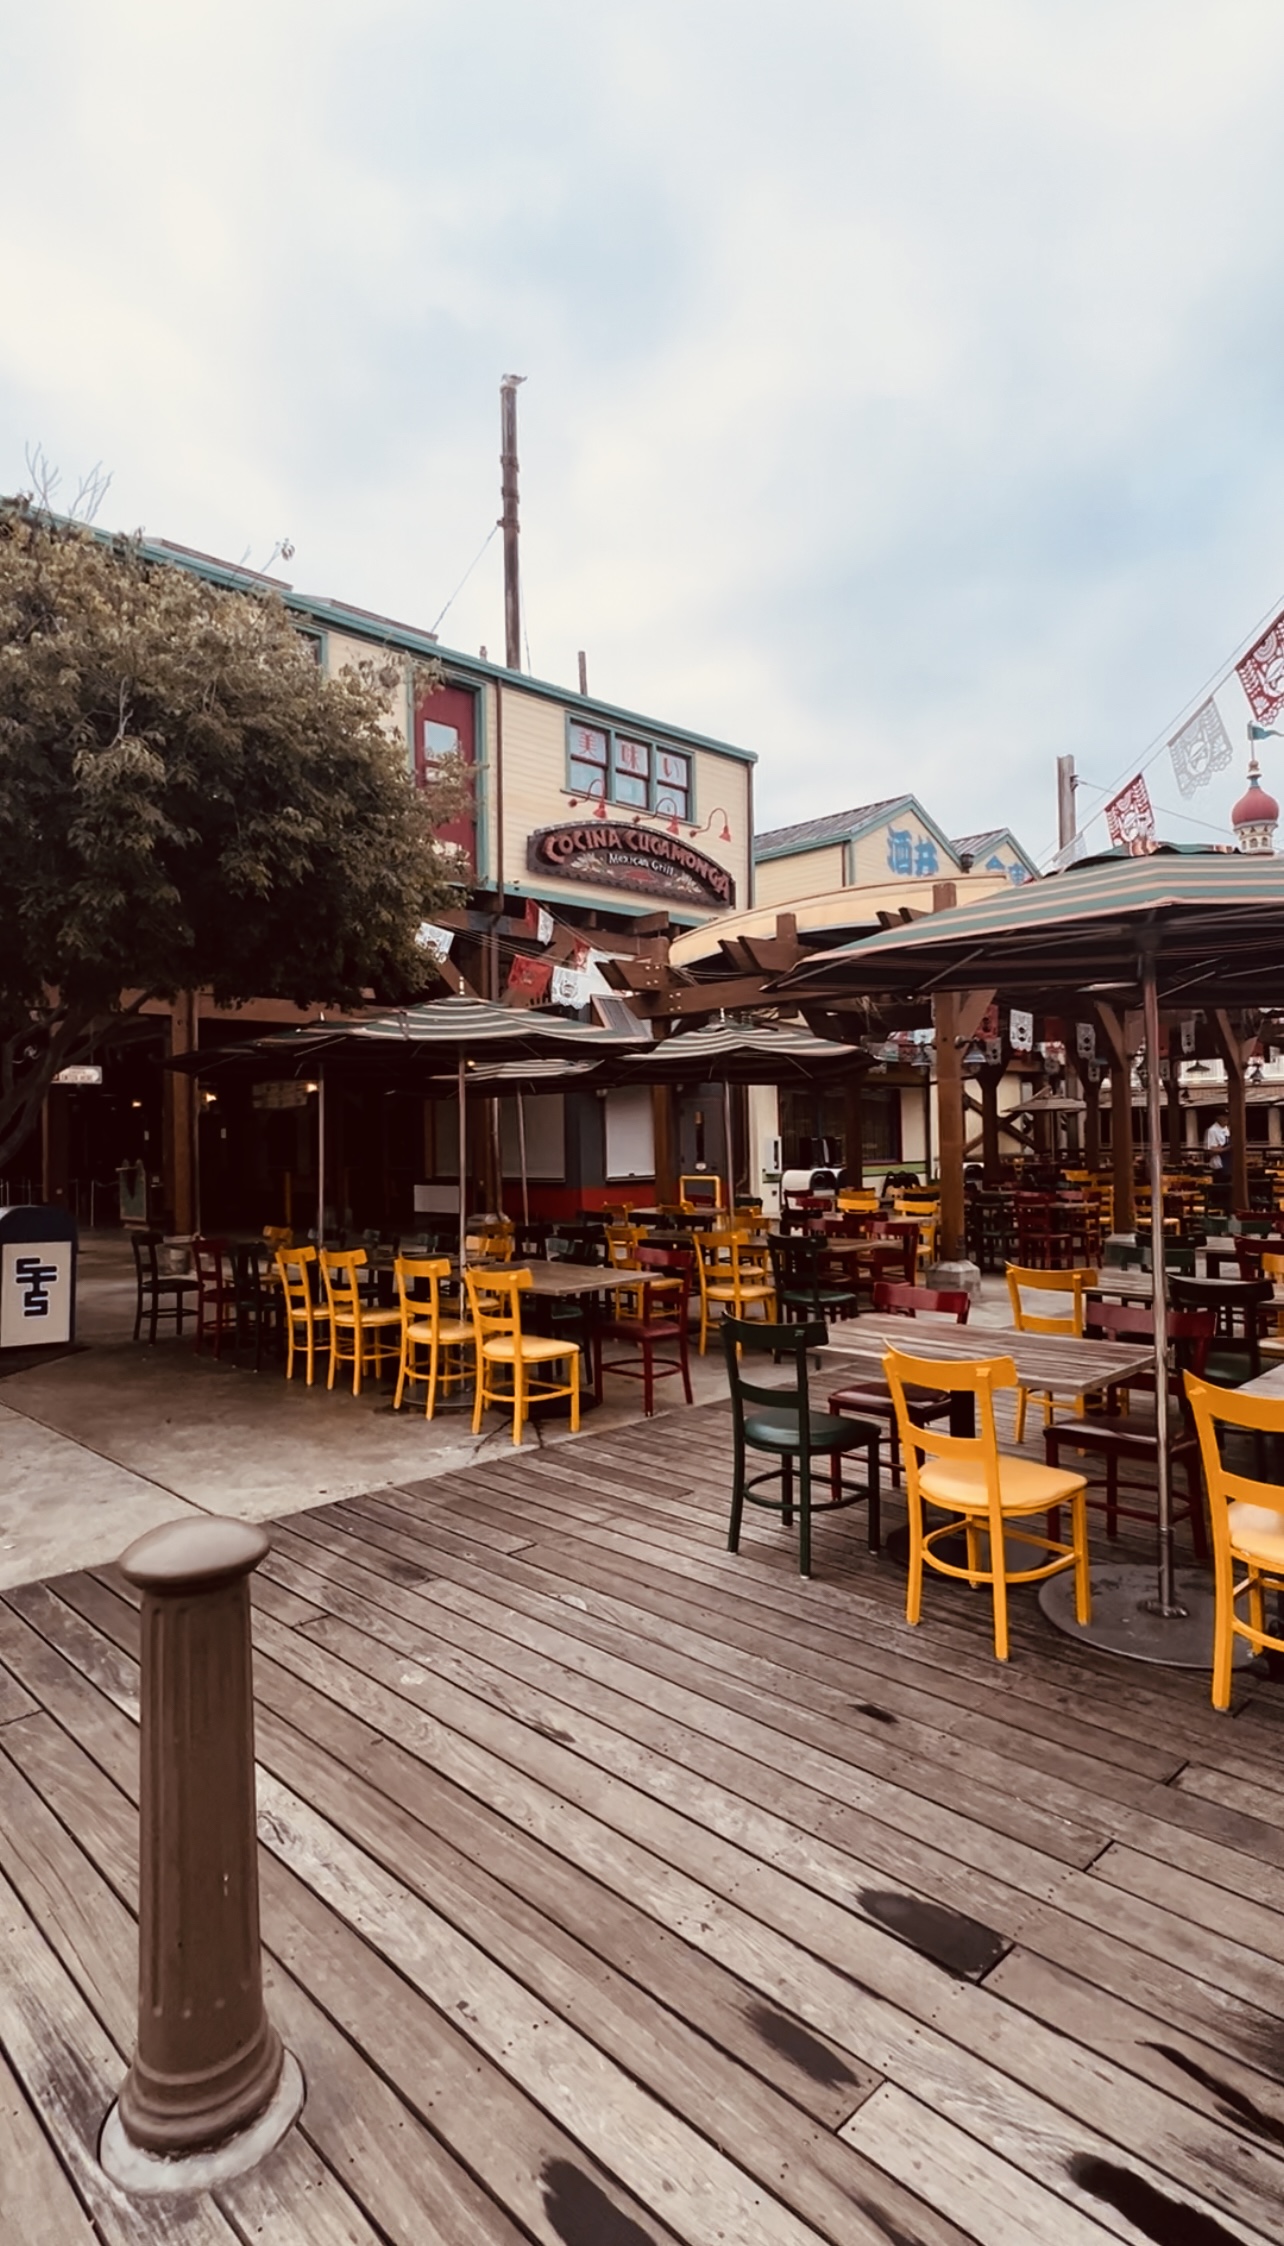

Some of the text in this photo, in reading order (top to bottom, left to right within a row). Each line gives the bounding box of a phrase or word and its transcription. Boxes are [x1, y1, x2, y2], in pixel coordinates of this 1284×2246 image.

[545, 829, 622, 863] COCINA
[609, 852, 674, 876] Mexican Grill
